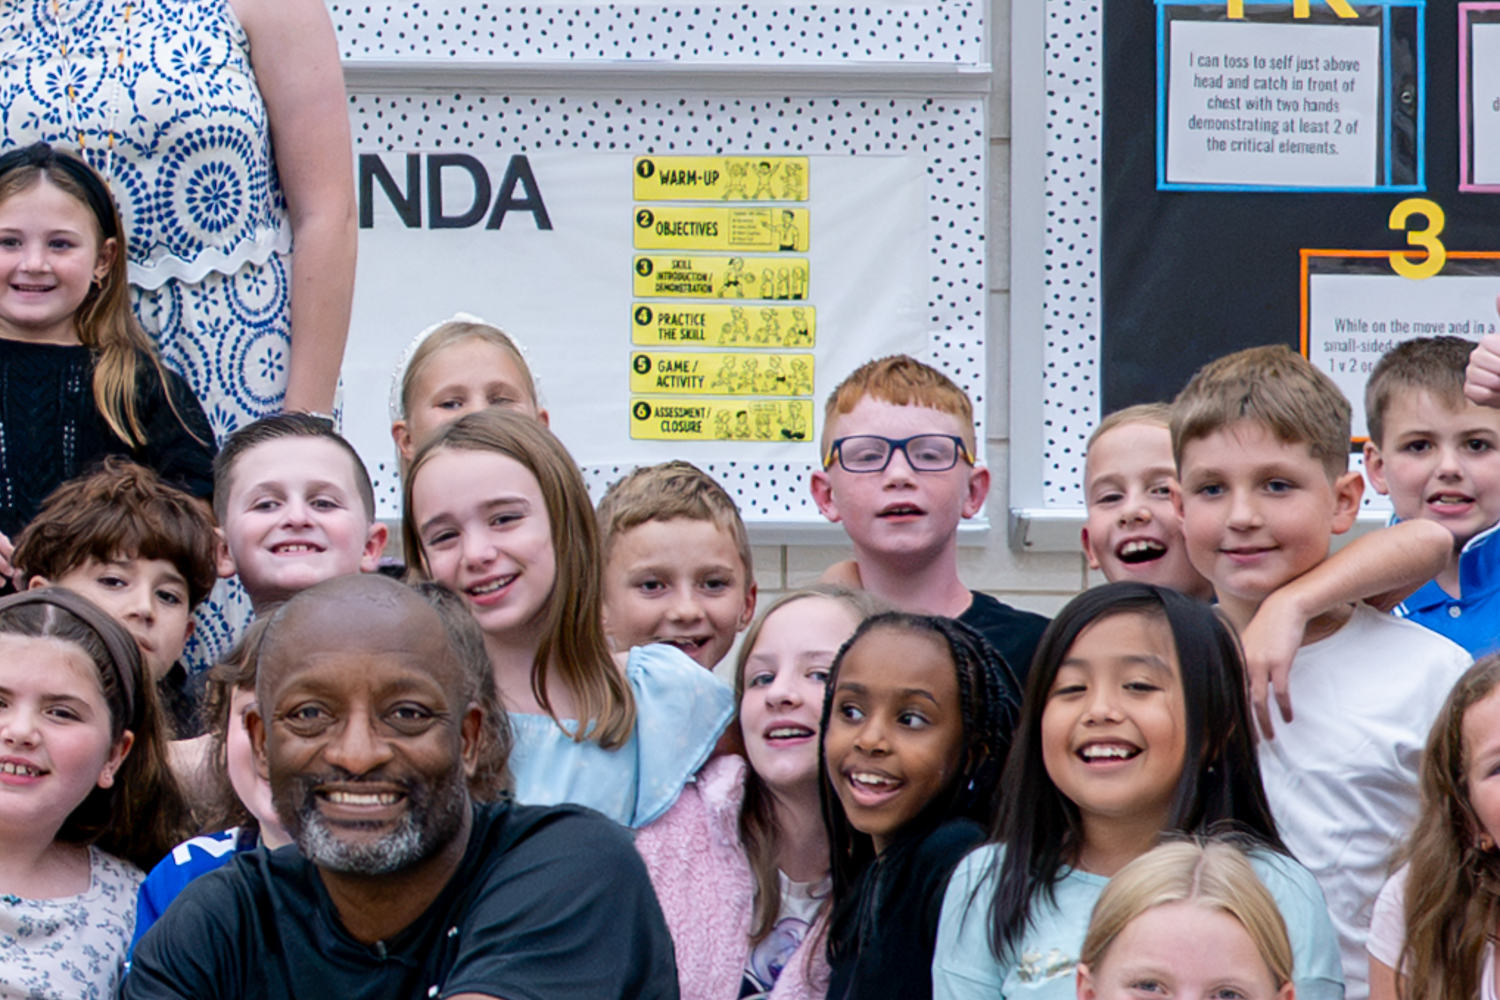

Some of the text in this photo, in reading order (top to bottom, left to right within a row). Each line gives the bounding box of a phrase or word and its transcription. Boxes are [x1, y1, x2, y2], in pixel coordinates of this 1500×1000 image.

[1189, 52, 1361, 73] I can toss to self just above
[1193, 74, 1356, 92] head and catch in front of
[1207, 95, 1340, 113] chest with two hands
[1188, 114, 1359, 135] demonstrating at least 2 of
[1206, 137, 1339, 155] the critical elements.
[658, 169, 720, 186] WARM-UP
[655, 221, 719, 236] OBJECTIVES
[1388, 197, 1446, 280] 3
[657, 312, 706, 326] PRACTICE
[1334, 317, 1495, 334] While on the move and in a
[658, 328, 706, 341] THE SKILL
[1323, 337, 1393, 353] small-sided
[657, 360, 690, 373] GAME
[1329, 358, 1334, 372] 1
[1338, 361, 1345, 372] v
[1349, 357, 1358, 372] 2
[656, 375, 705, 388] ACTIVITY
[660, 420, 703, 433] CLOSURE
